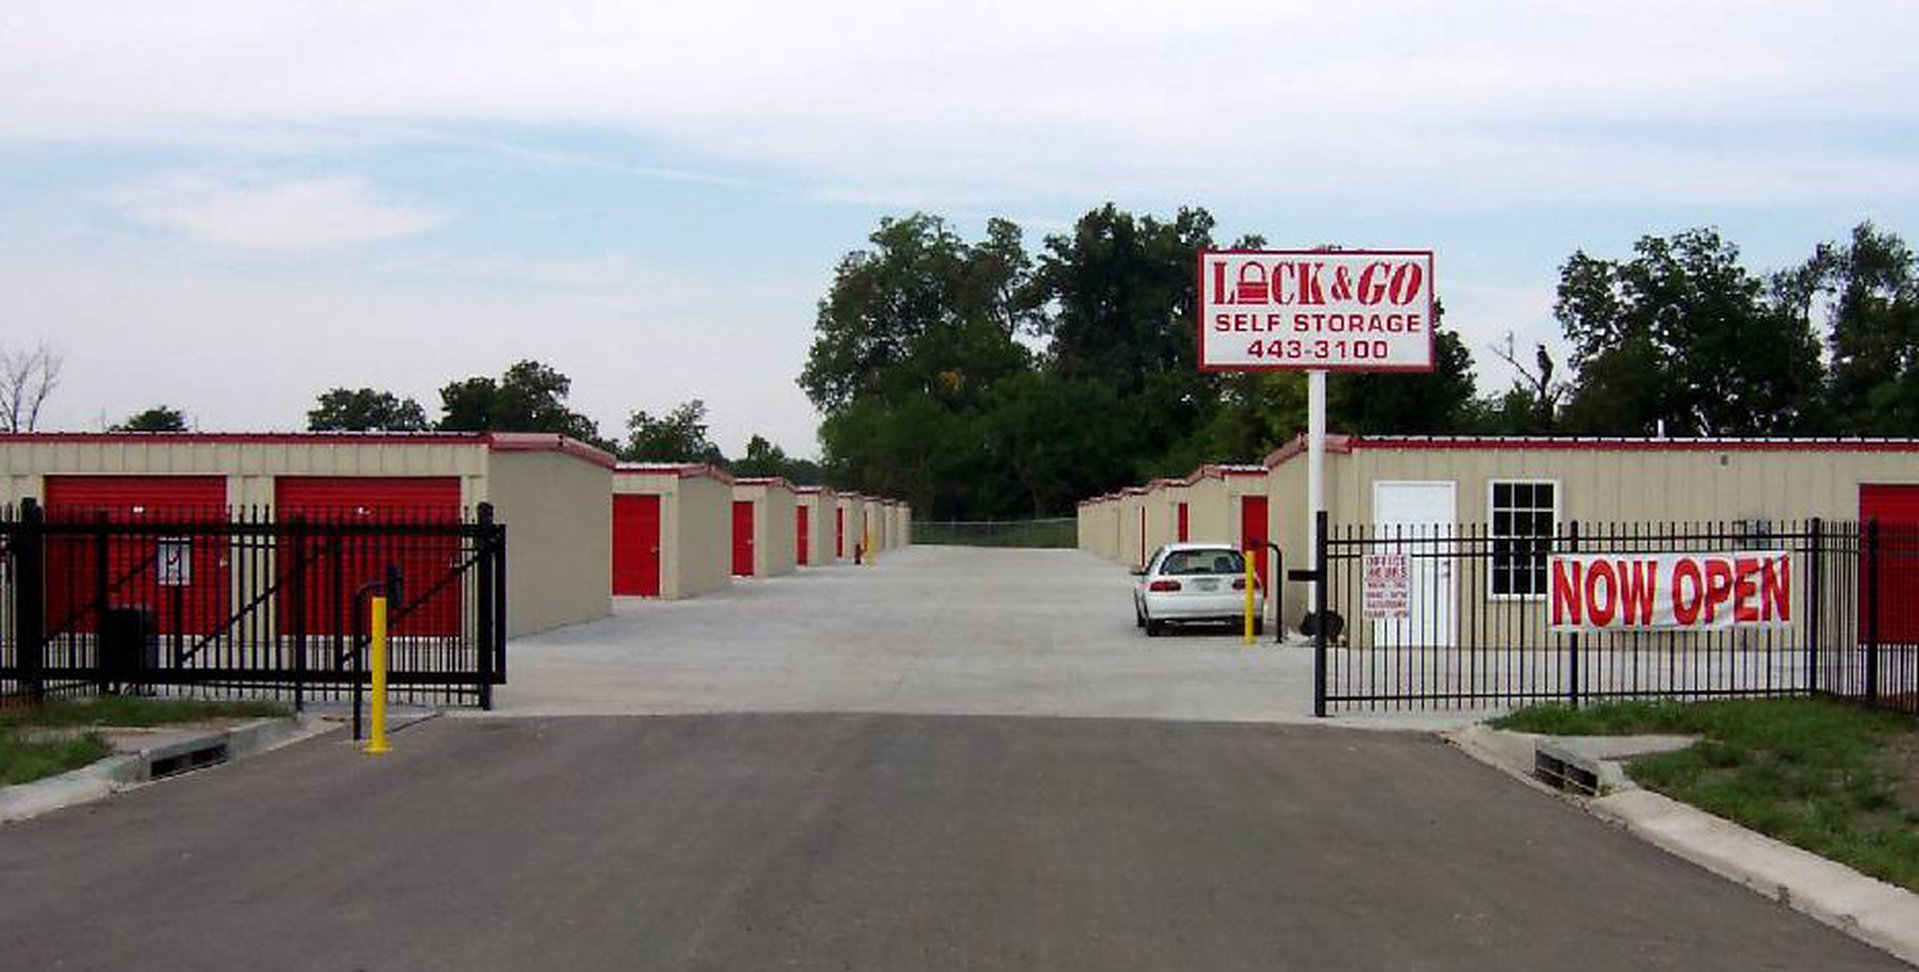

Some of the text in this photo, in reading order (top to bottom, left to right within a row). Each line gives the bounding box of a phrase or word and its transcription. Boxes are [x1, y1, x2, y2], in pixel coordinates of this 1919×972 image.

[1215, 314, 1421, 332] SELF STORAGE
[1247, 340, 1389, 359] 443-3100
[1552, 554, 1791, 627] NOW OPEN
